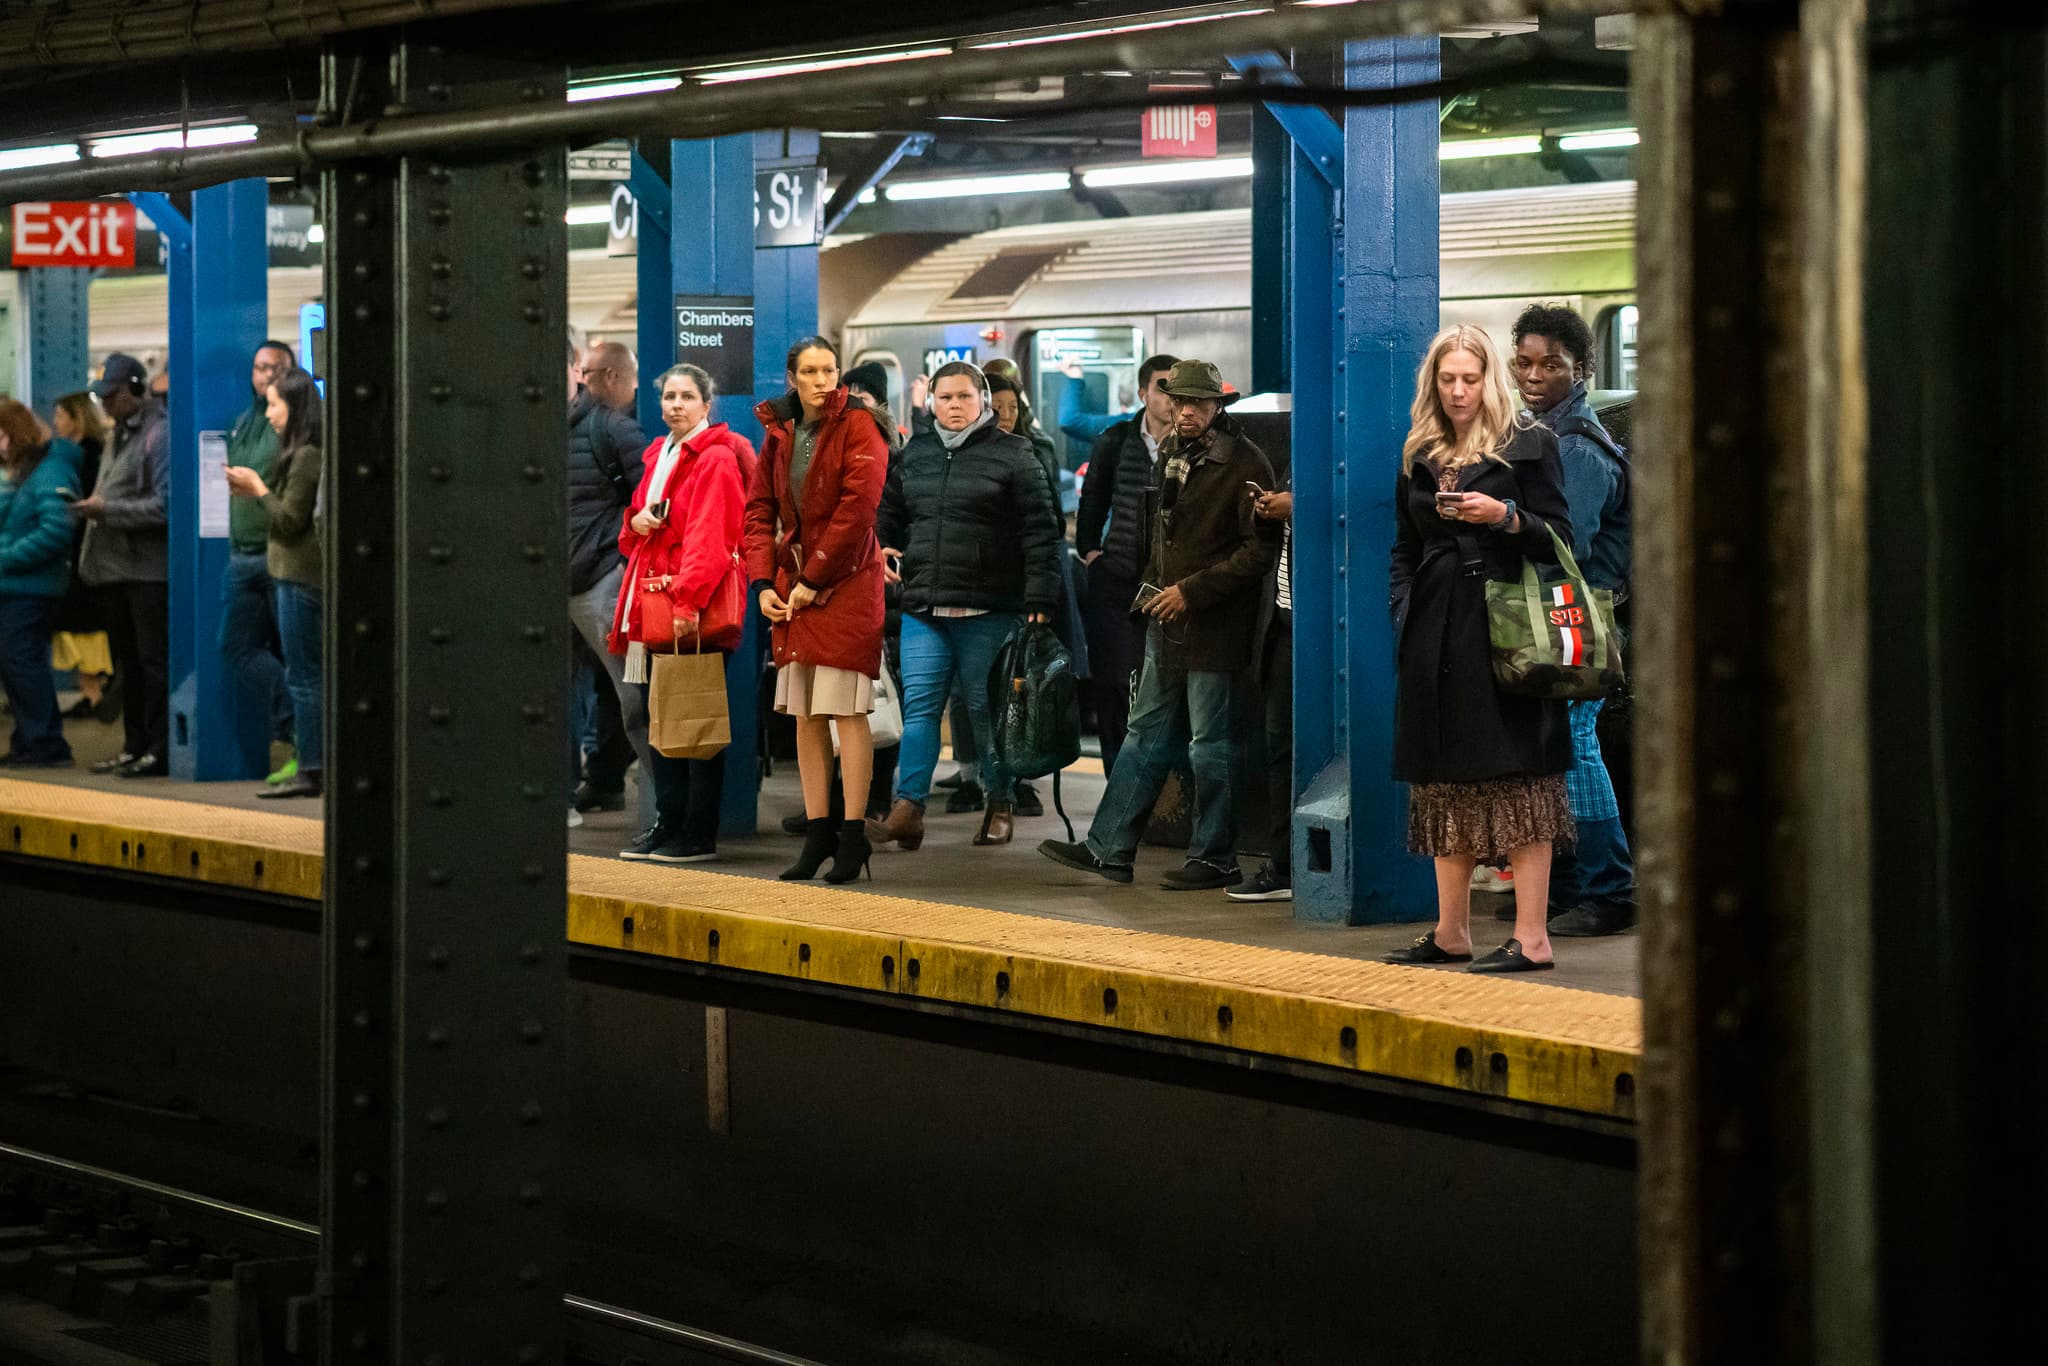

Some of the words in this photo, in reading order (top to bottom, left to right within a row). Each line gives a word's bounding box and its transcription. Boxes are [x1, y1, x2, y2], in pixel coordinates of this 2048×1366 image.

[768, 172, 803, 229] St
[15, 205, 123, 255] Exit
[679, 310, 754, 326] Chambers
[679, 331, 723, 347] Street
